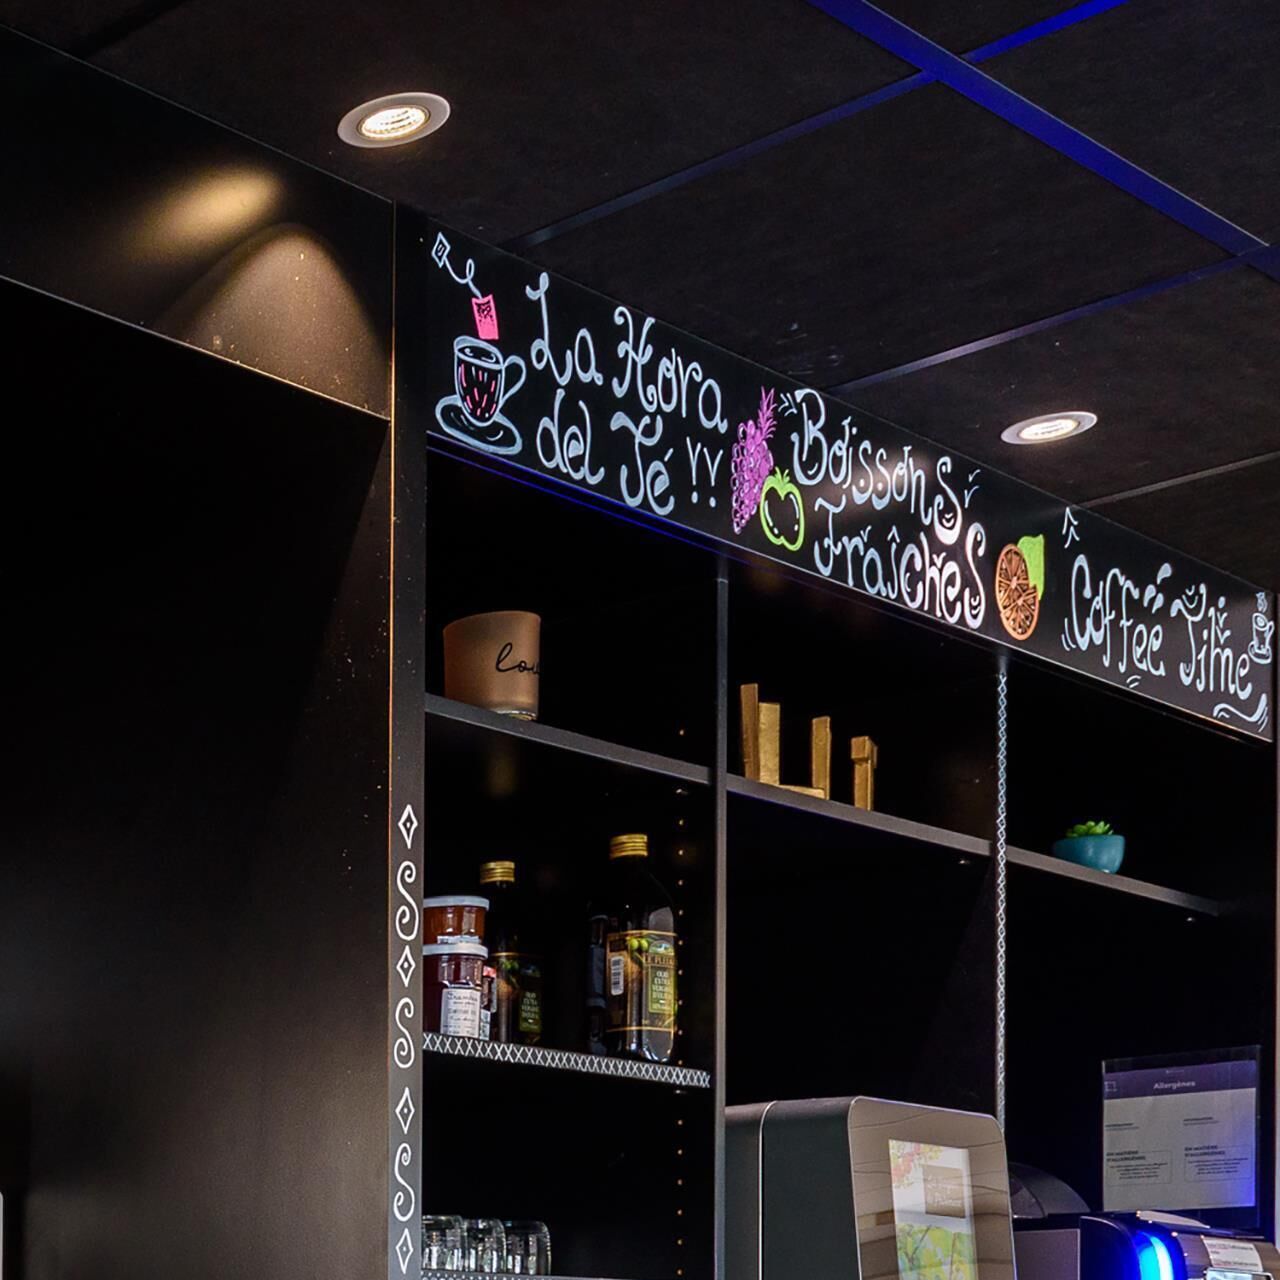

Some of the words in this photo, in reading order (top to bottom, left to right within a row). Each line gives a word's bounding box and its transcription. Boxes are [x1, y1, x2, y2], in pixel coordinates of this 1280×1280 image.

[525, 272, 603, 387] La
[611, 306, 728, 434] Hora
[536, 389, 605, 485] del
[1072, 554, 1166, 674] Coffee
[1170, 583, 1252, 700] Time
